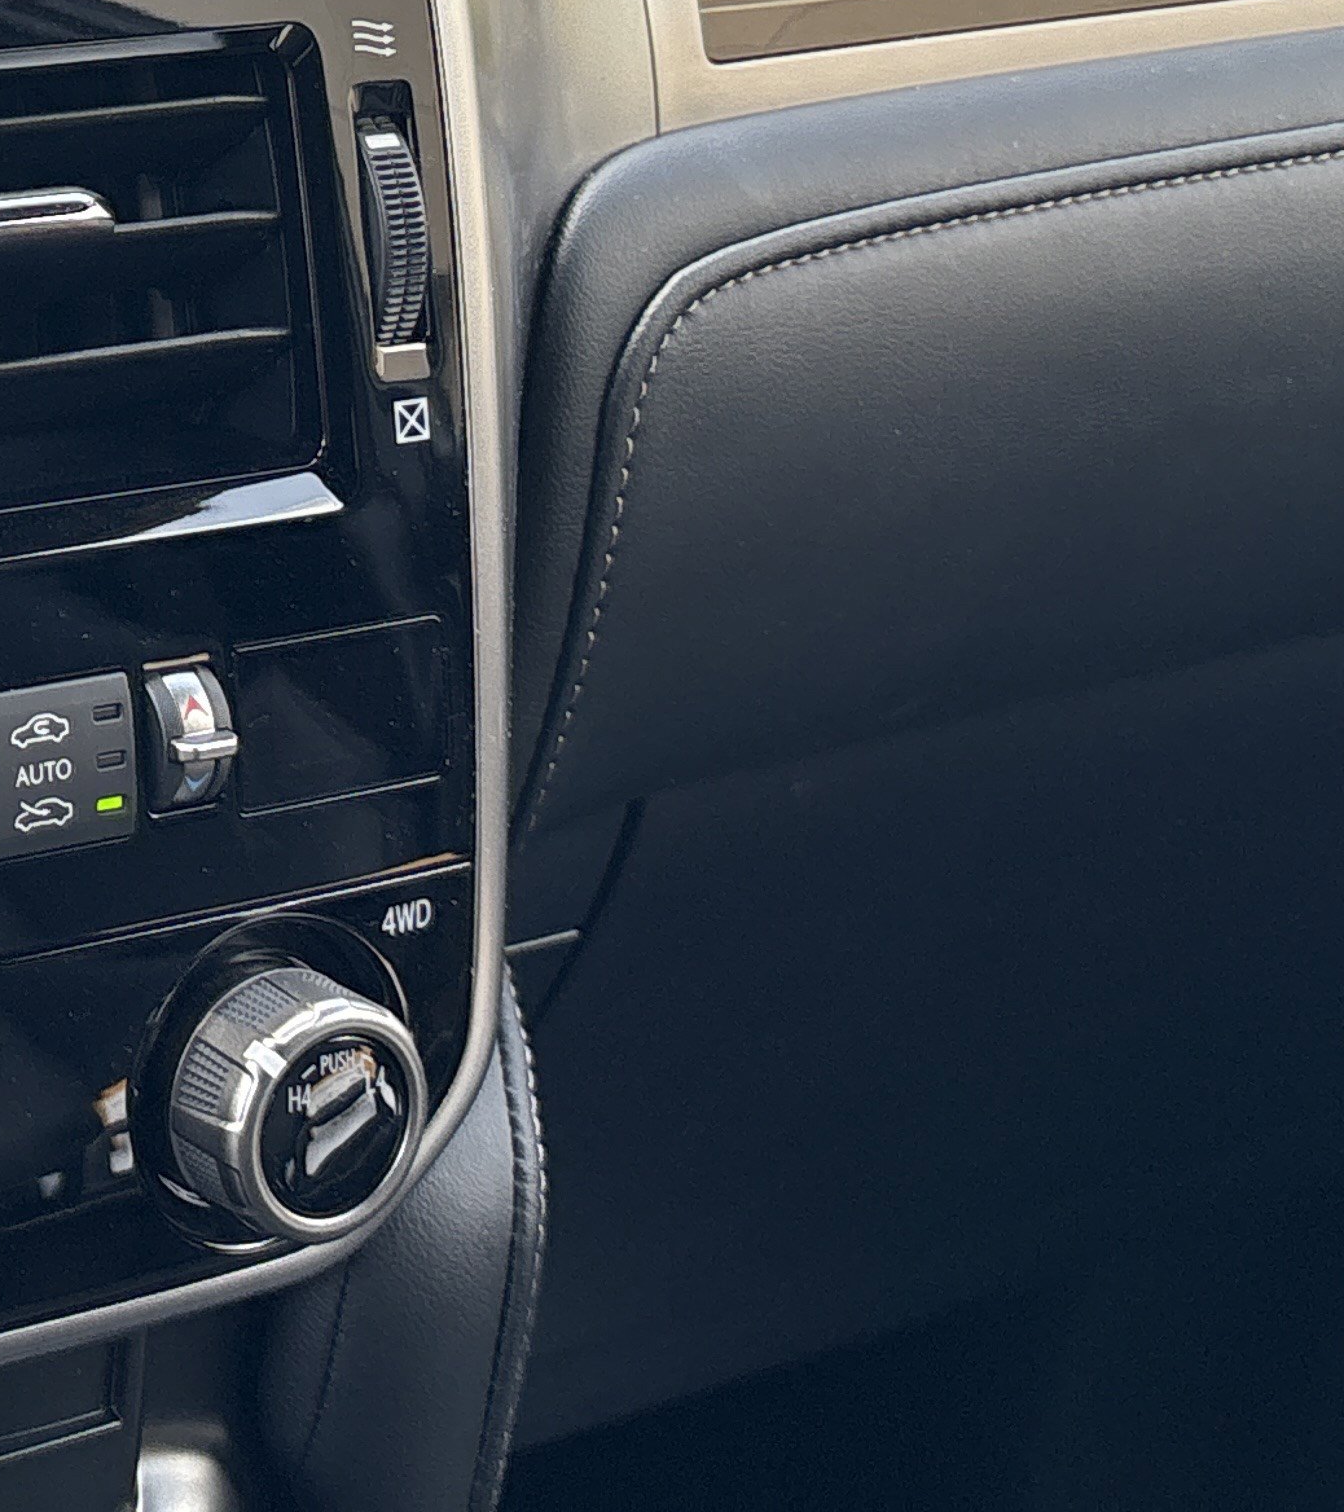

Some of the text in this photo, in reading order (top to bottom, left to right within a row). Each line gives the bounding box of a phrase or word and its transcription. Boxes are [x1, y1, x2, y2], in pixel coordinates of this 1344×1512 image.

[15, 757, 72, 787] AUTO
[381, 898, 432, 937] 4WD
[319, 1048, 358, 1077] PUSH
